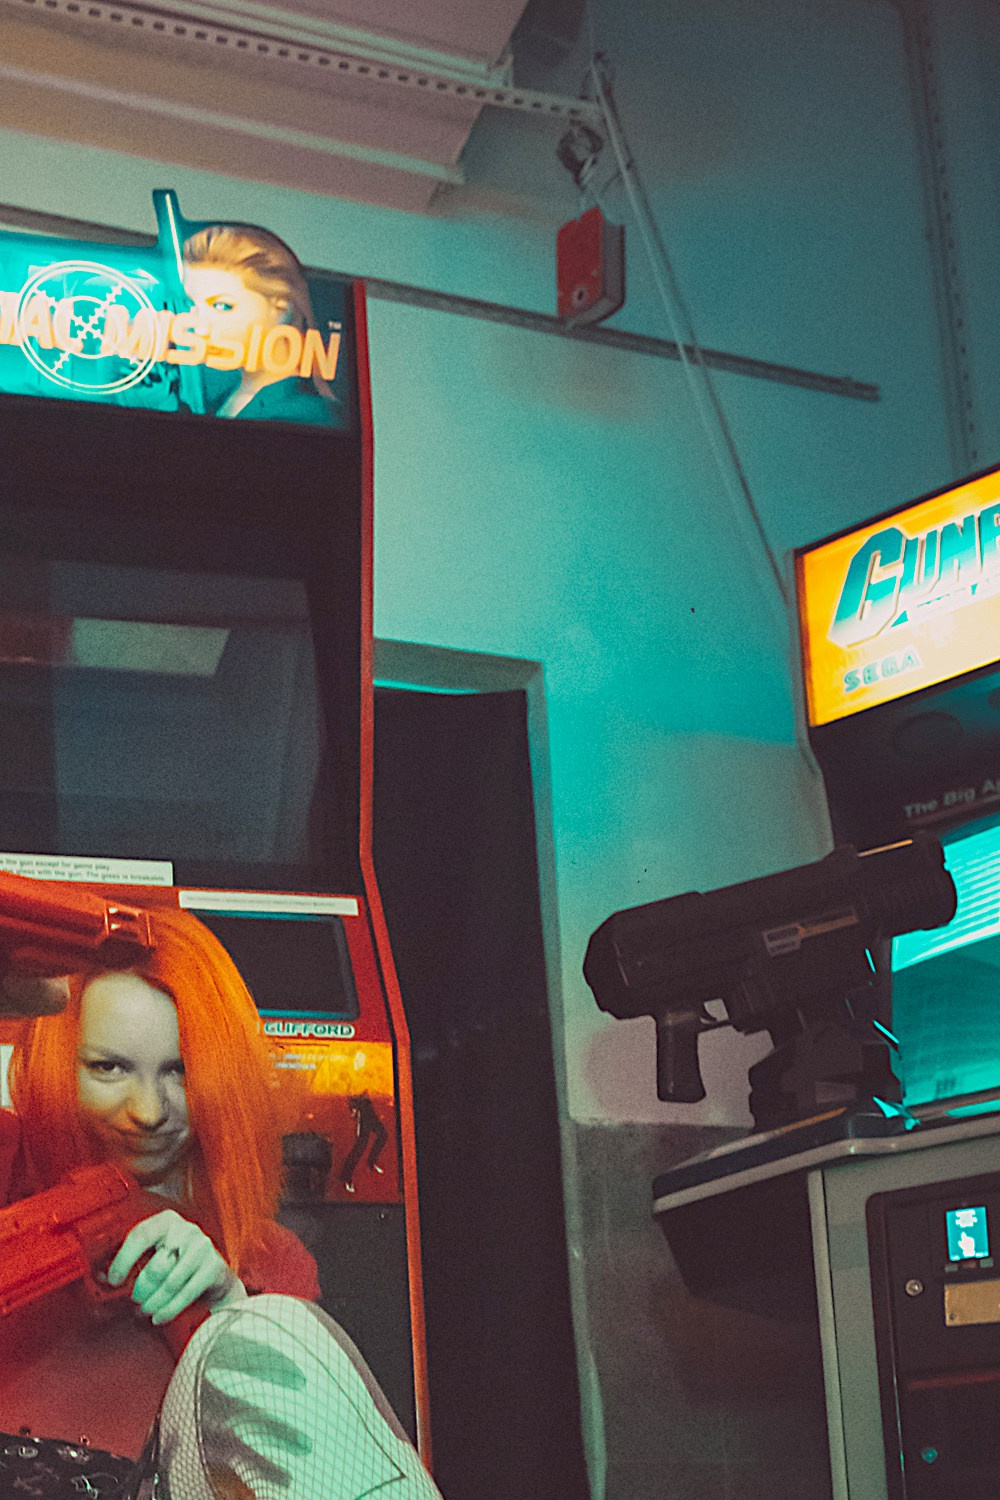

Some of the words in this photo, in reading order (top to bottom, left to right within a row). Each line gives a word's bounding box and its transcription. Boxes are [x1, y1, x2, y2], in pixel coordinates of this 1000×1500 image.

[100, 302, 342, 381] MISSION
[843, 648, 921, 693] SEGA
[904, 800, 939, 818] The
[944, 787, 977, 807] Big
